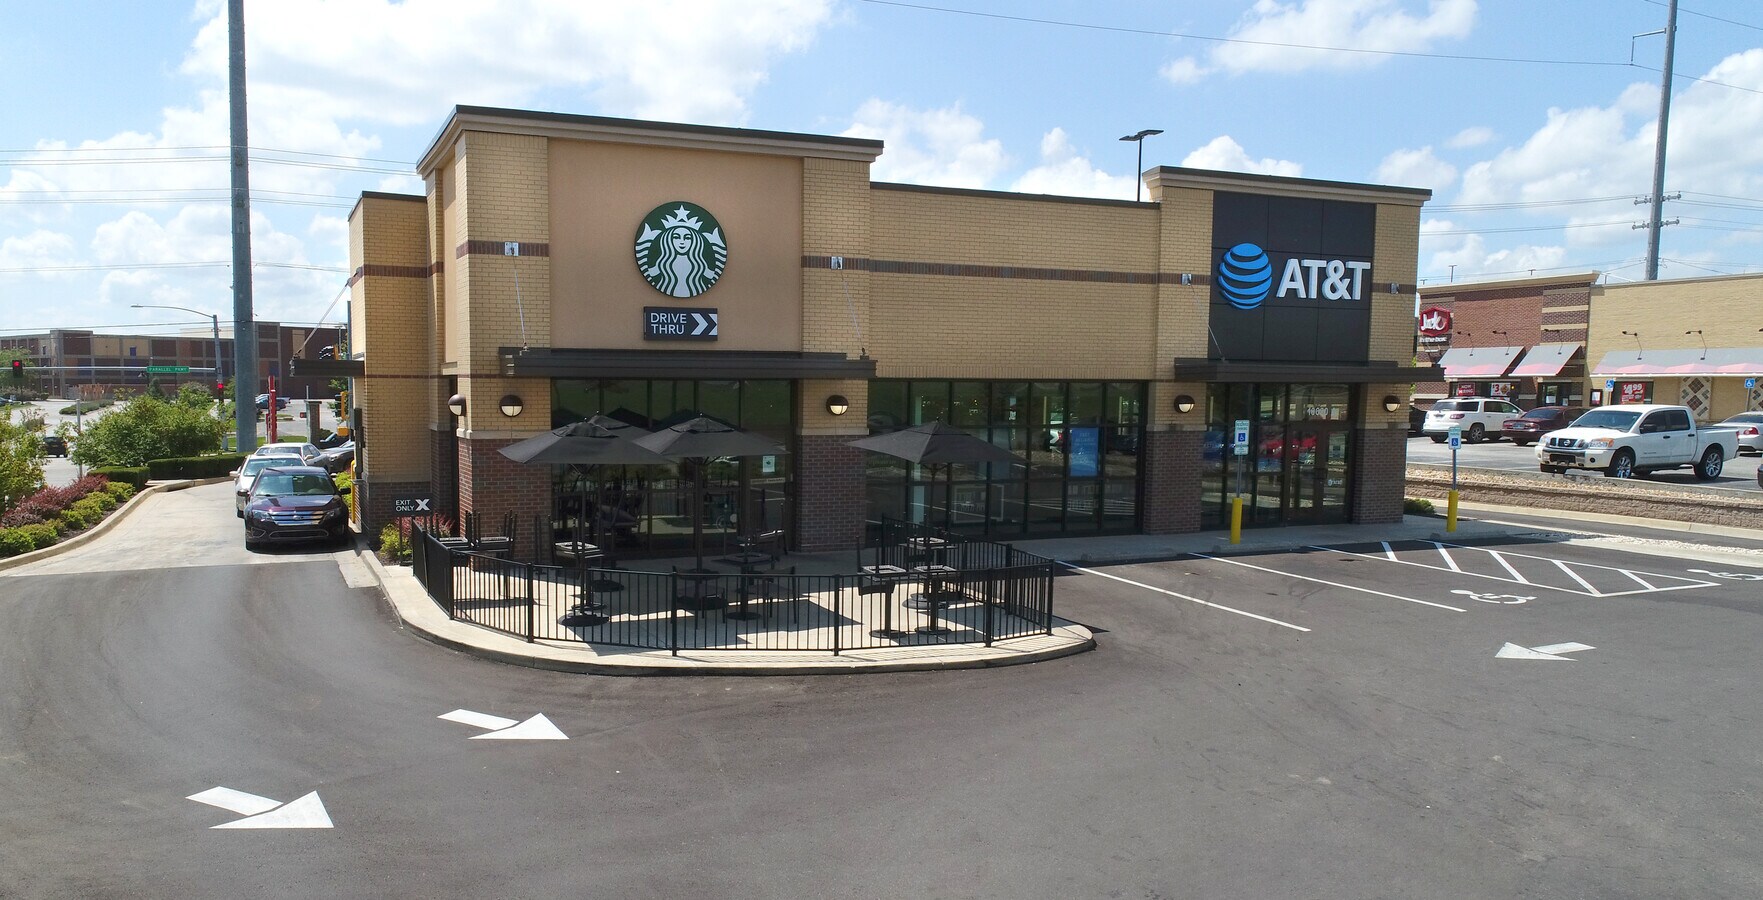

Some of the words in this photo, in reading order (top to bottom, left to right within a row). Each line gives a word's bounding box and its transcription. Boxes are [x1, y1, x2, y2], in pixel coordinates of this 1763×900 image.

[1276, 258, 1371, 300] AT&T
[650, 312, 687, 324] DRIVE
[651, 323, 685, 335] THRU
